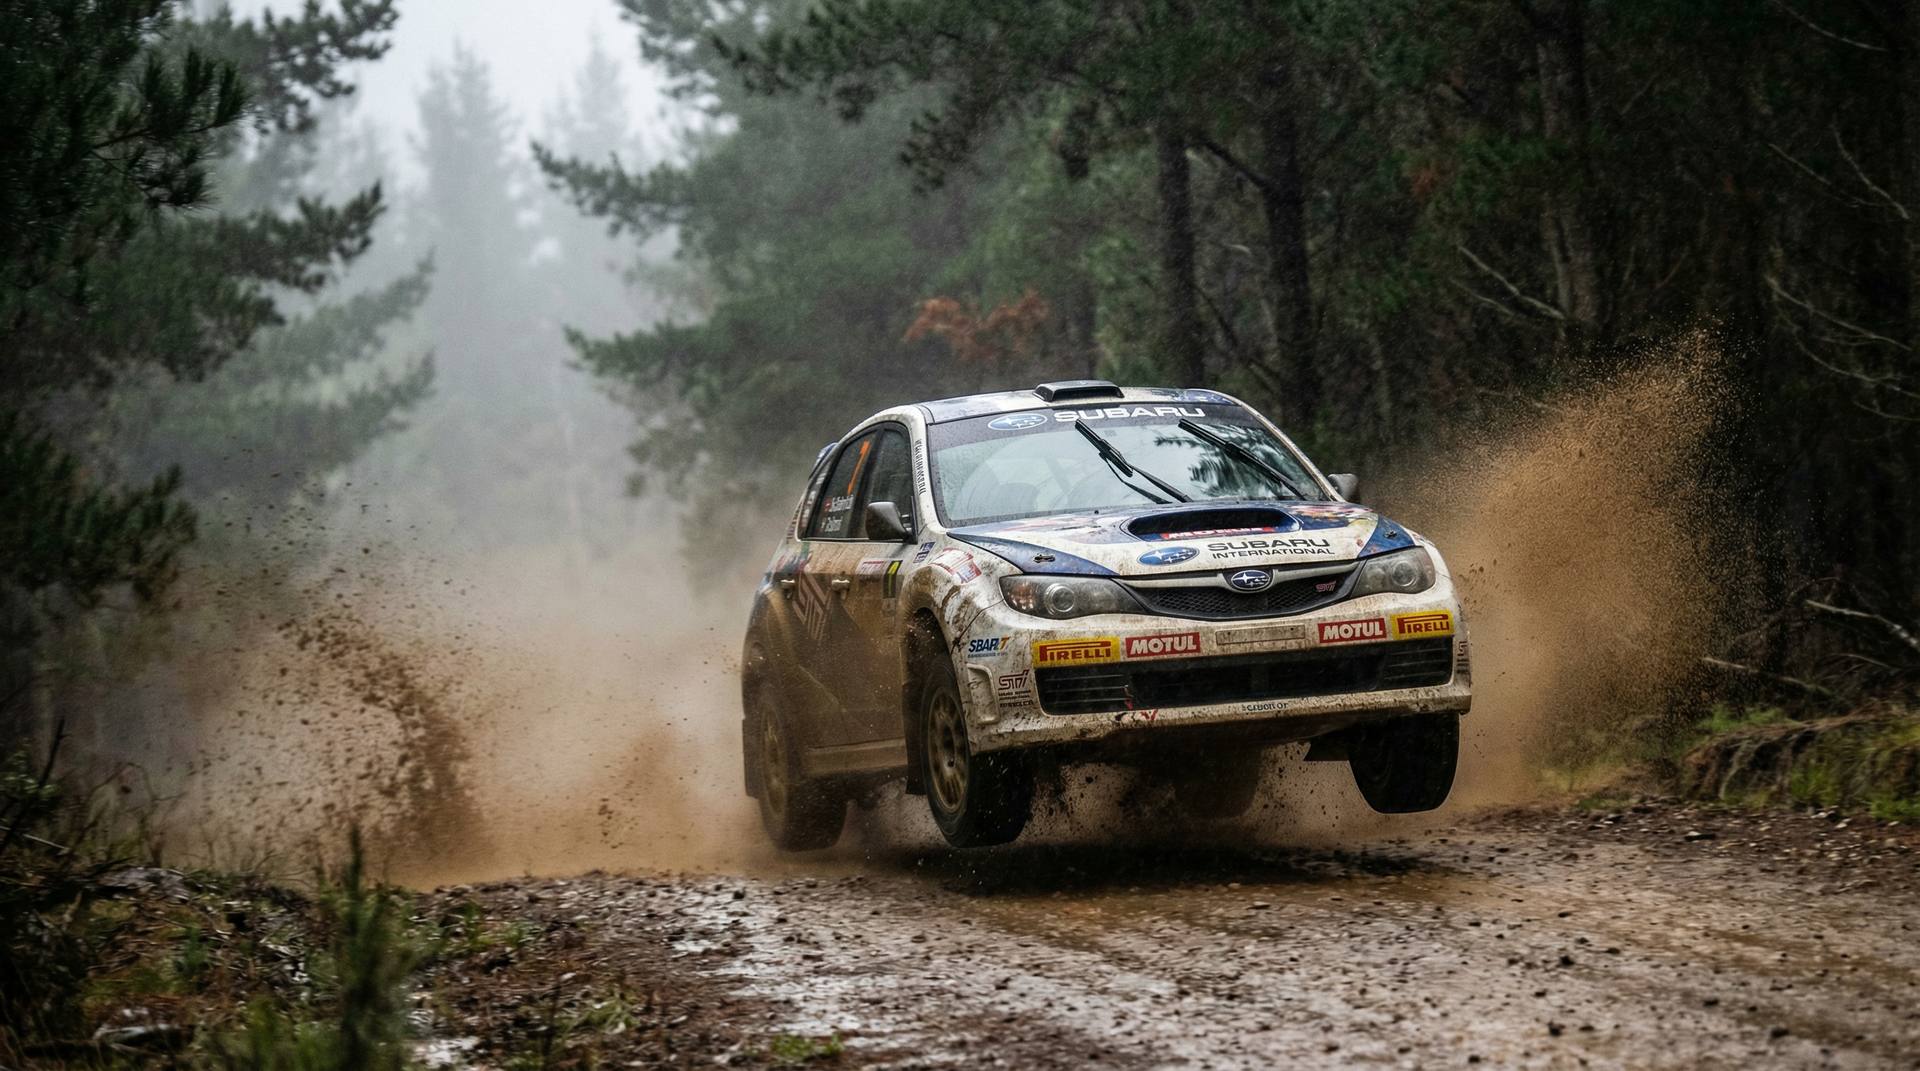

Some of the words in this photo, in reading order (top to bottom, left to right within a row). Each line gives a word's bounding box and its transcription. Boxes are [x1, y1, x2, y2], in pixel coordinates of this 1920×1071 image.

[1053, 407, 1206, 422] SUBARU
[1207, 538, 1331, 551] SUBARU
[1212, 548, 1336, 559] INTERNATIONAL
[1322, 621, 1384, 641] MOTUL
[1396, 613, 1450, 635] PIRELLI
[1039, 640, 1112, 662] PIRELLI
[1130, 635, 1197, 655] MOTUL
